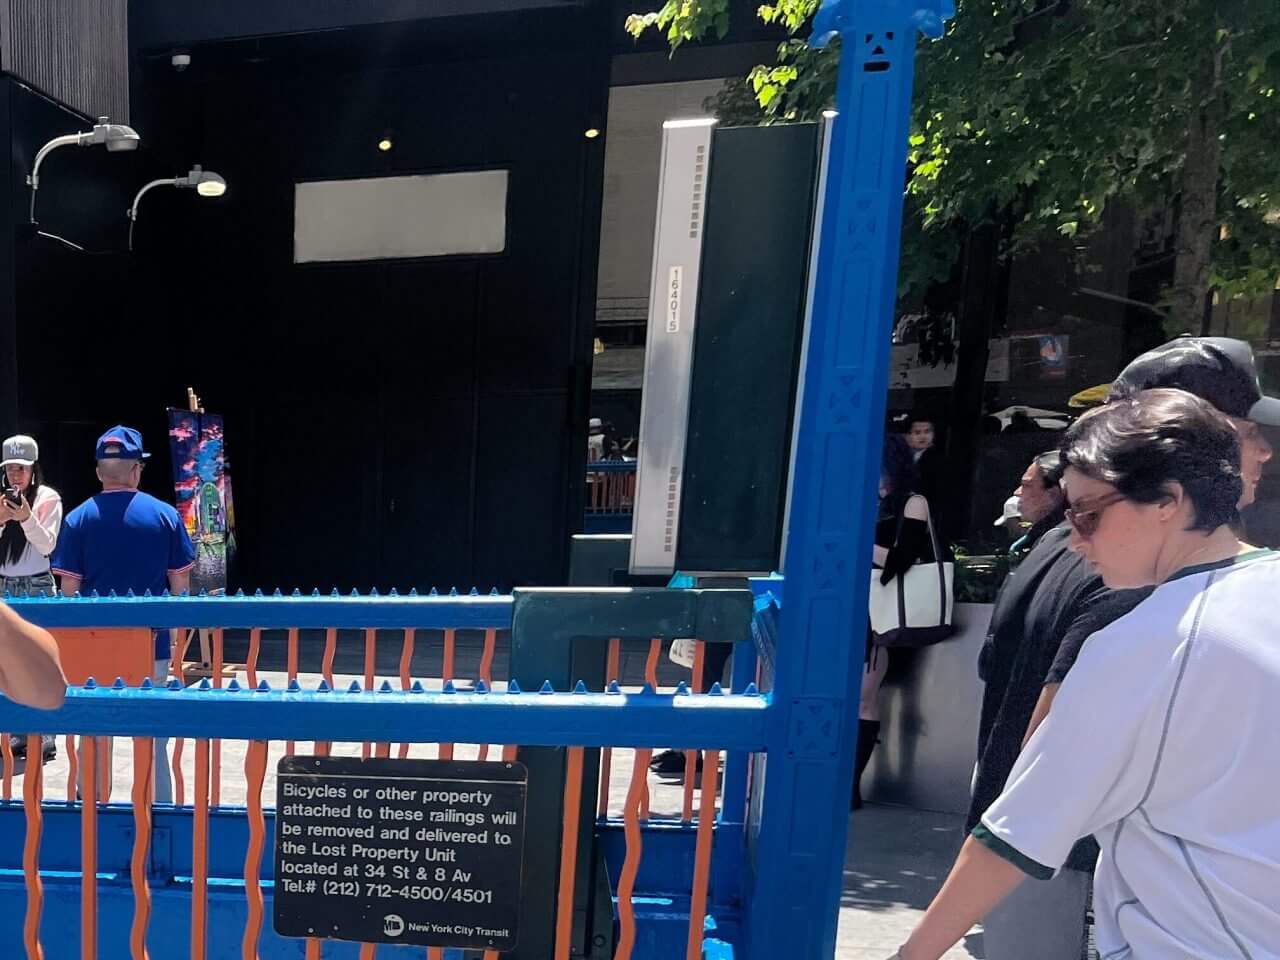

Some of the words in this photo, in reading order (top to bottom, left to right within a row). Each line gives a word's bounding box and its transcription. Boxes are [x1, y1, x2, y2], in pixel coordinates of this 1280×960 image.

[669, 269, 679, 331] 164015
[283, 782, 346, 801] Bicycles
[353, 787, 369, 799] or
[376, 786, 416, 802] other
[423, 789, 492, 807] property
[282, 804, 351, 819] attached
[357, 806, 373, 819] to
[379, 807, 423, 821] these
[430, 810, 485, 826] railings
[492, 811, 517, 825] will
[282, 822, 302, 836] be
[308, 824, 374, 840] removed
[381, 827, 409, 841] and
[416, 828, 487, 844] delivered
[494, 831, 511, 845] to
[282, 841, 306, 855] the
[312, 843, 346, 857] Lost
[352, 845, 419, 863] Property
[425, 848, 456, 862] Unit
[282, 861, 337, 876] located
[344, 864, 358, 877] at
[365, 863, 386, 877] 34
[392, 865, 409, 879] St
[416, 867, 428, 880] &
[434, 868, 445, 881] 8
[452, 868, 471, 883] Av
[323, 880, 360, 897] (212)
[365, 883, 493, 904] 712-4500/4501
[408, 922, 429, 933] New
[431, 923, 453, 934] York
[454, 924, 475, 937] City
[476, 926, 509, 938] Transit
